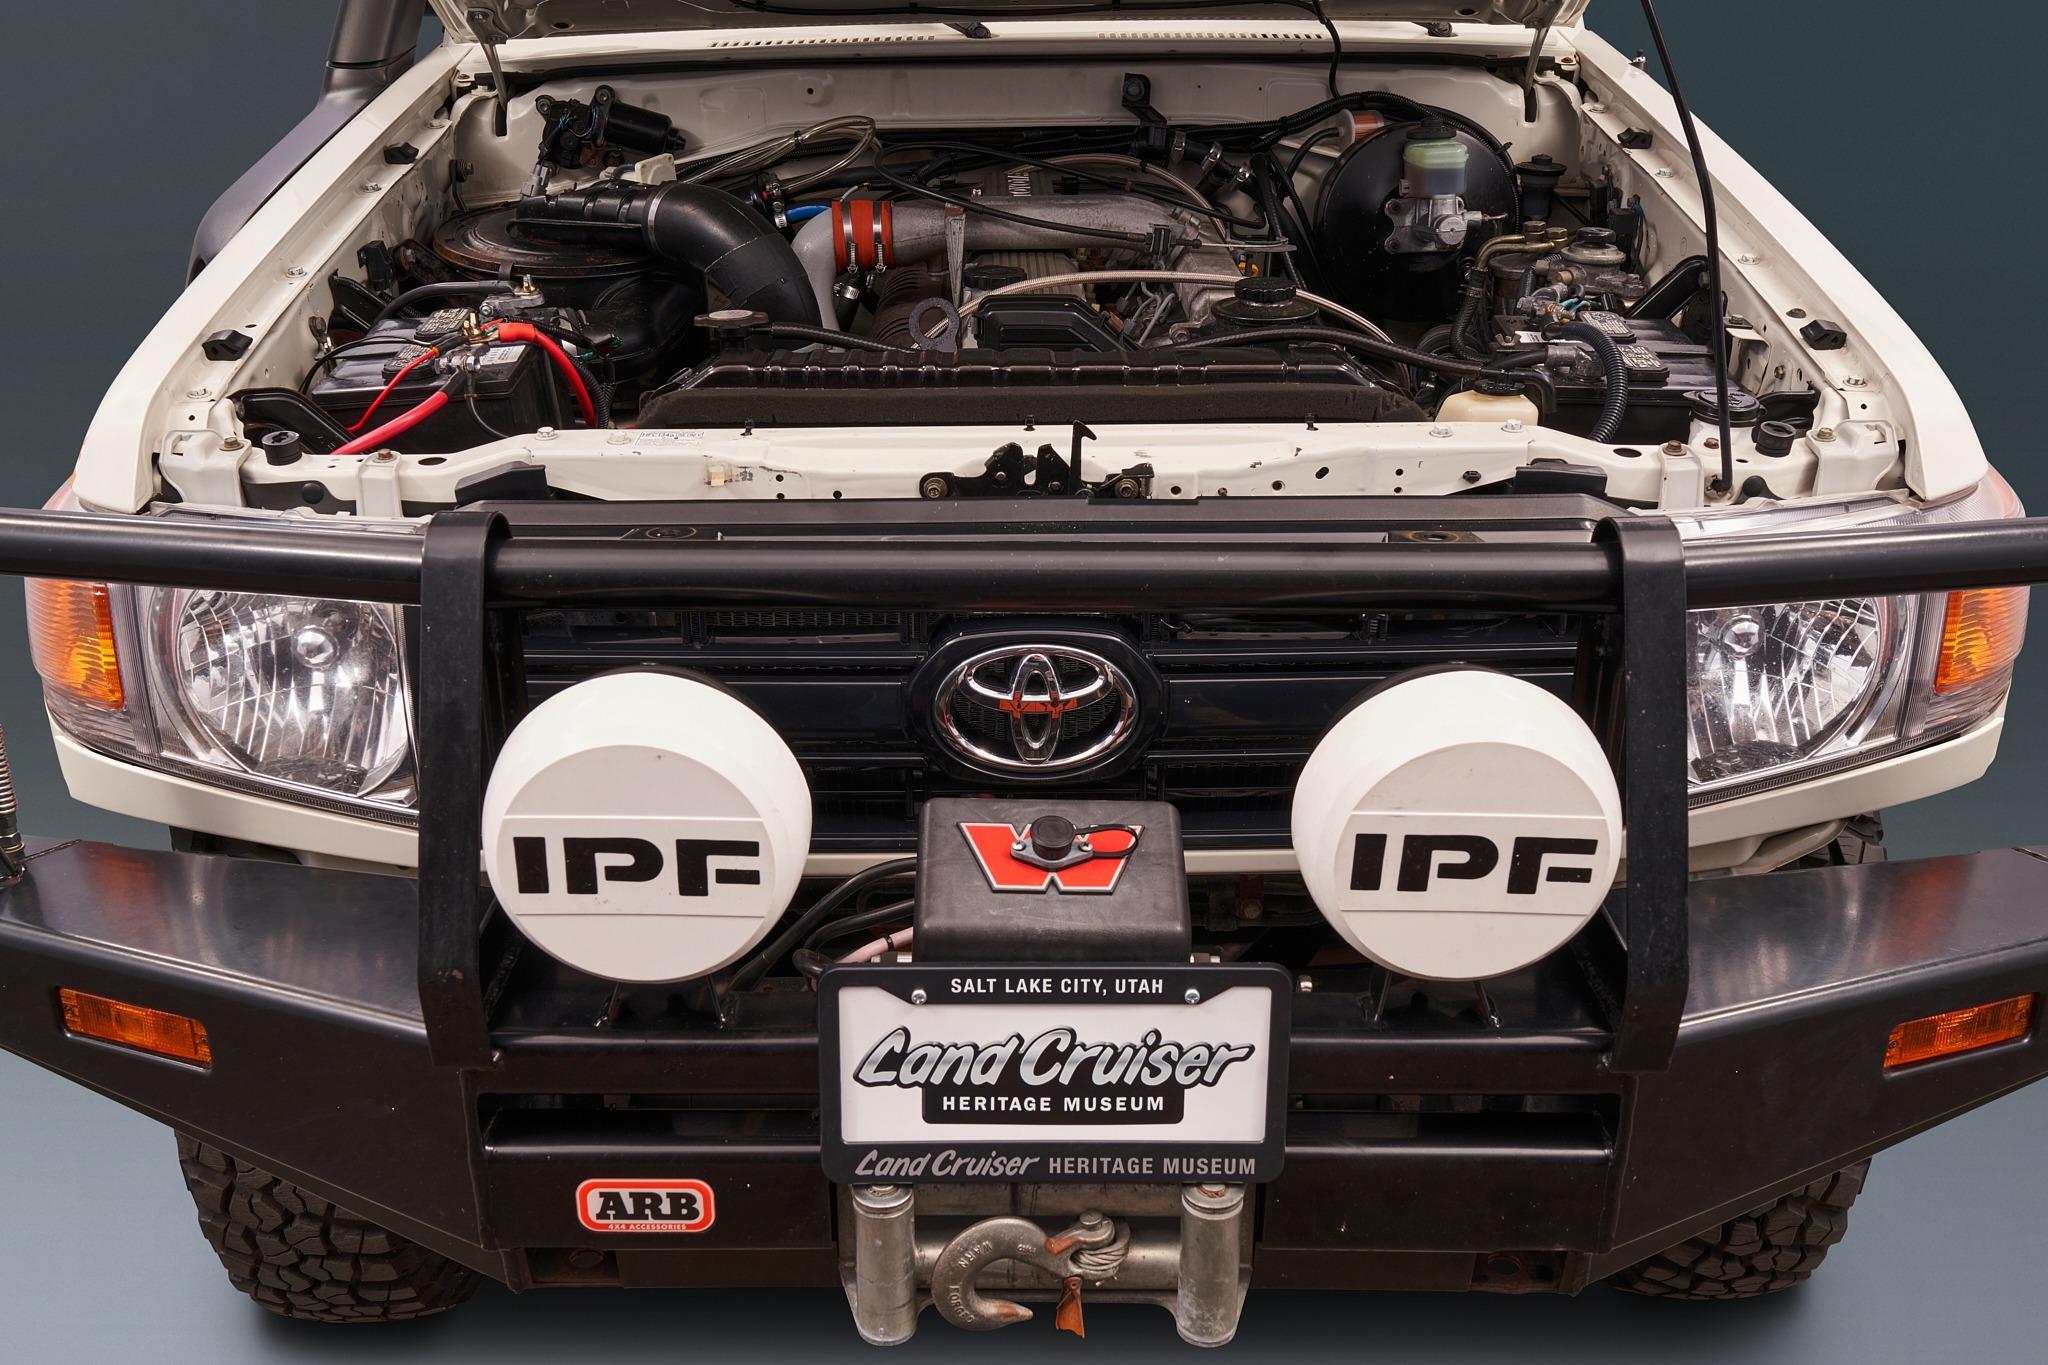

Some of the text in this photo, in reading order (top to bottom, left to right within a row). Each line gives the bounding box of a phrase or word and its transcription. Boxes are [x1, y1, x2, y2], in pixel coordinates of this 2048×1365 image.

[513, 836, 760, 897] IPF
[1350, 833, 1599, 894] IPF
[951, 978, 1163, 996] SALT LAKE CITY, UTAH
[853, 1025, 1255, 1089] Land Cruiser
[943, 1096, 1164, 1112] HERITAGE MUSEUM
[855, 1149, 1256, 1177] Land Cruiser HERITAGE MUSEUM
[595, 1191, 700, 1221] ARB
[608, 1223, 687, 1231] 4X4 ACCESSORIES
[958, 1240, 993, 1269] WARN
[948, 1285, 976, 1323] FORGED
